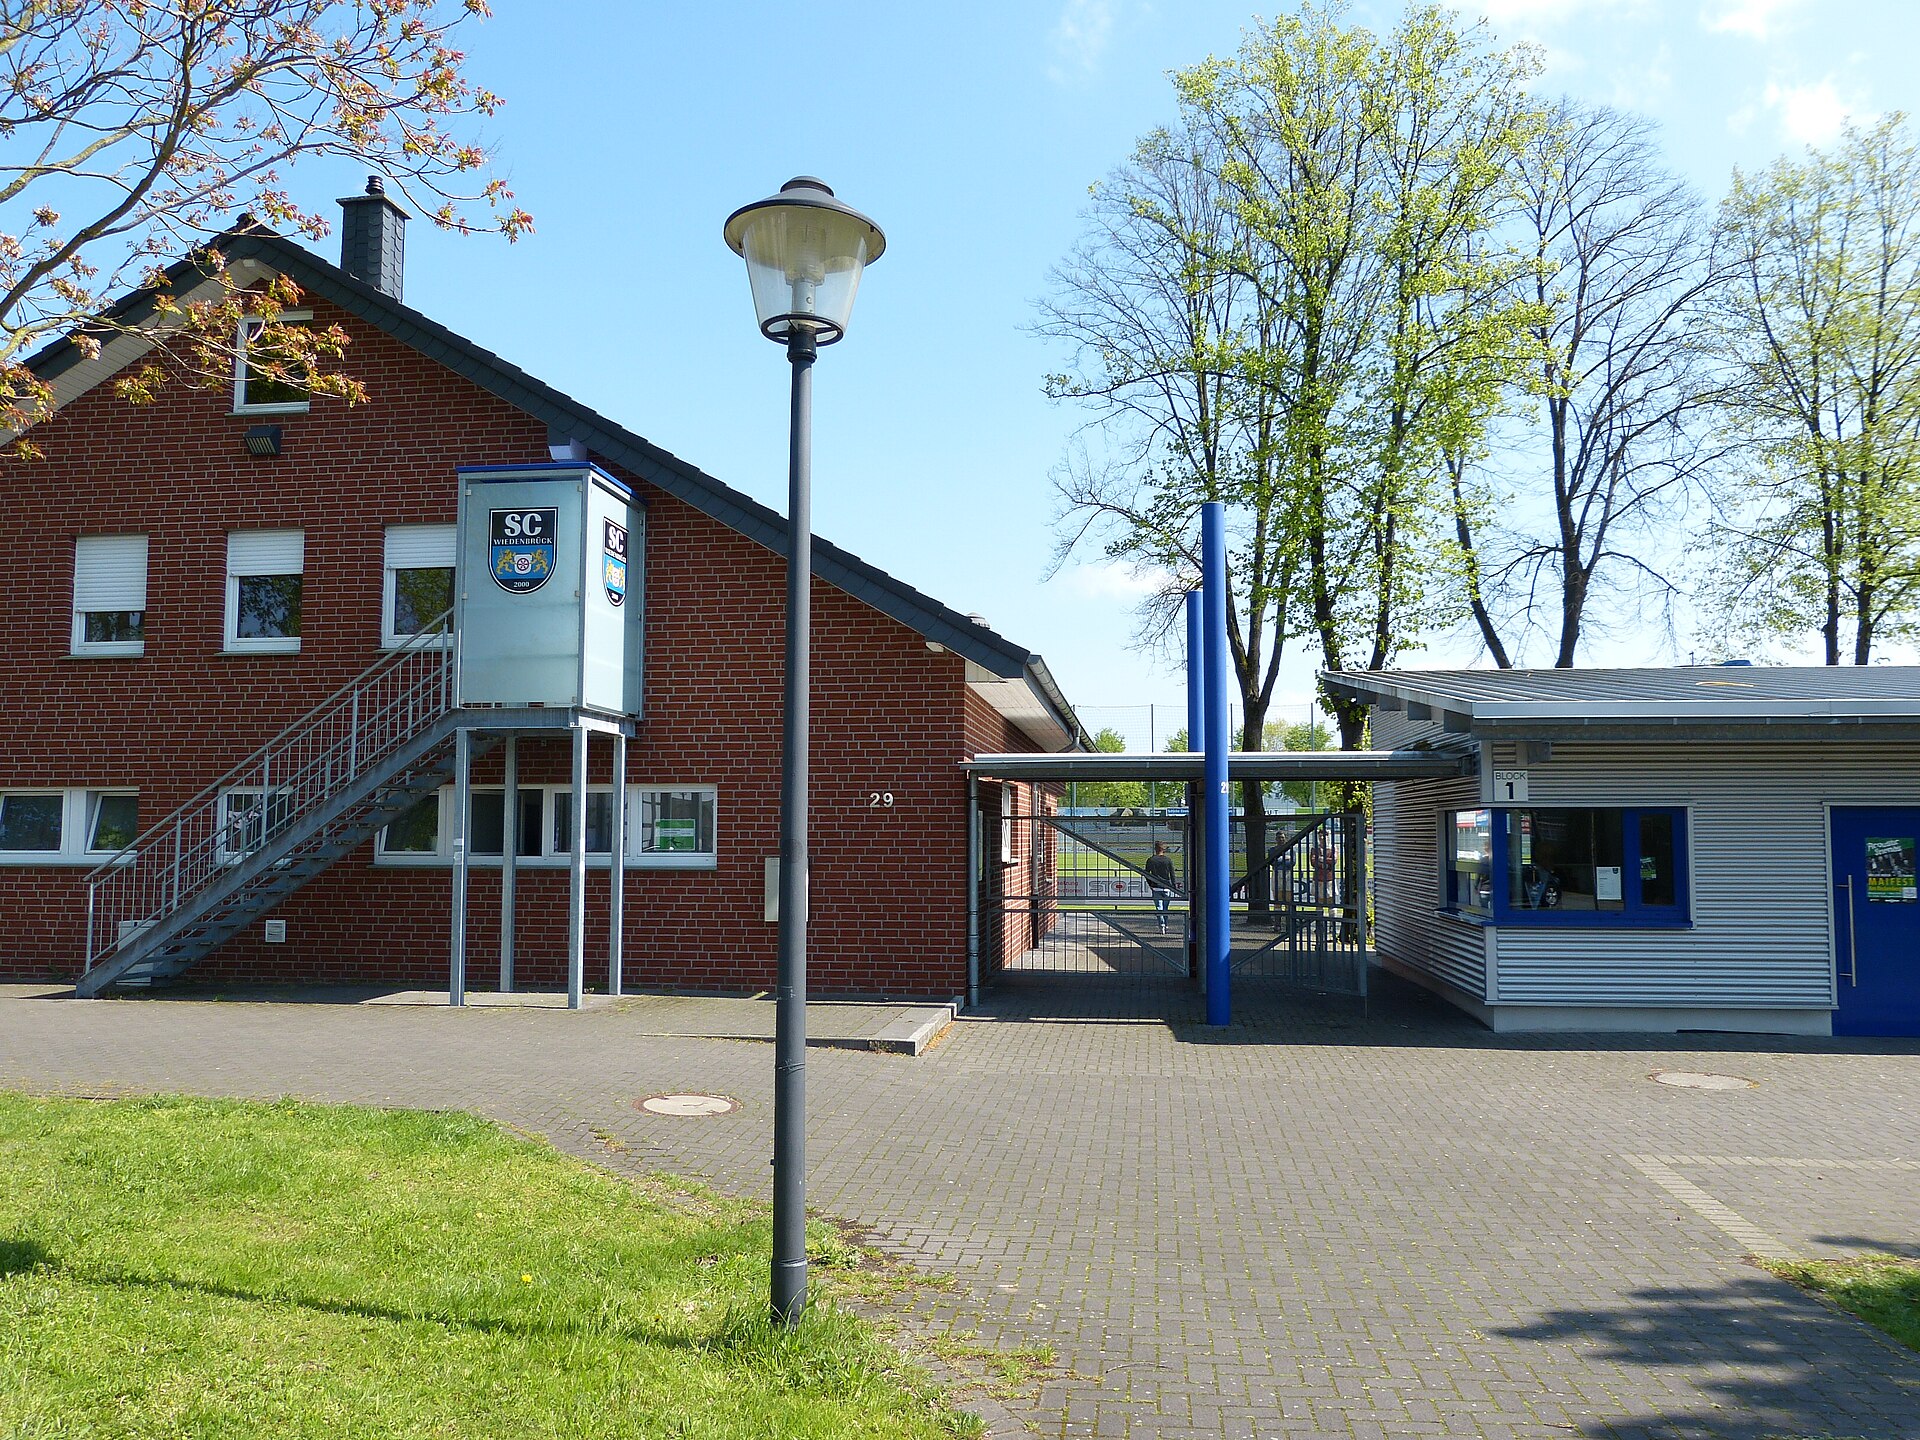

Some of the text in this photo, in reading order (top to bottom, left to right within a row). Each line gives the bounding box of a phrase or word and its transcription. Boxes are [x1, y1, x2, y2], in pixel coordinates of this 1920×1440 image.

[504, 513, 542, 536] SC
[493, 537, 553, 545] WIEDENBRÜCK
[608, 526, 624, 553] SC
[1495, 772, 1526, 780] BLOCK
[1505, 781, 1514, 800] 1
[870, 792, 893, 808] 29
[1868, 877, 1915, 886] MAIFEST
